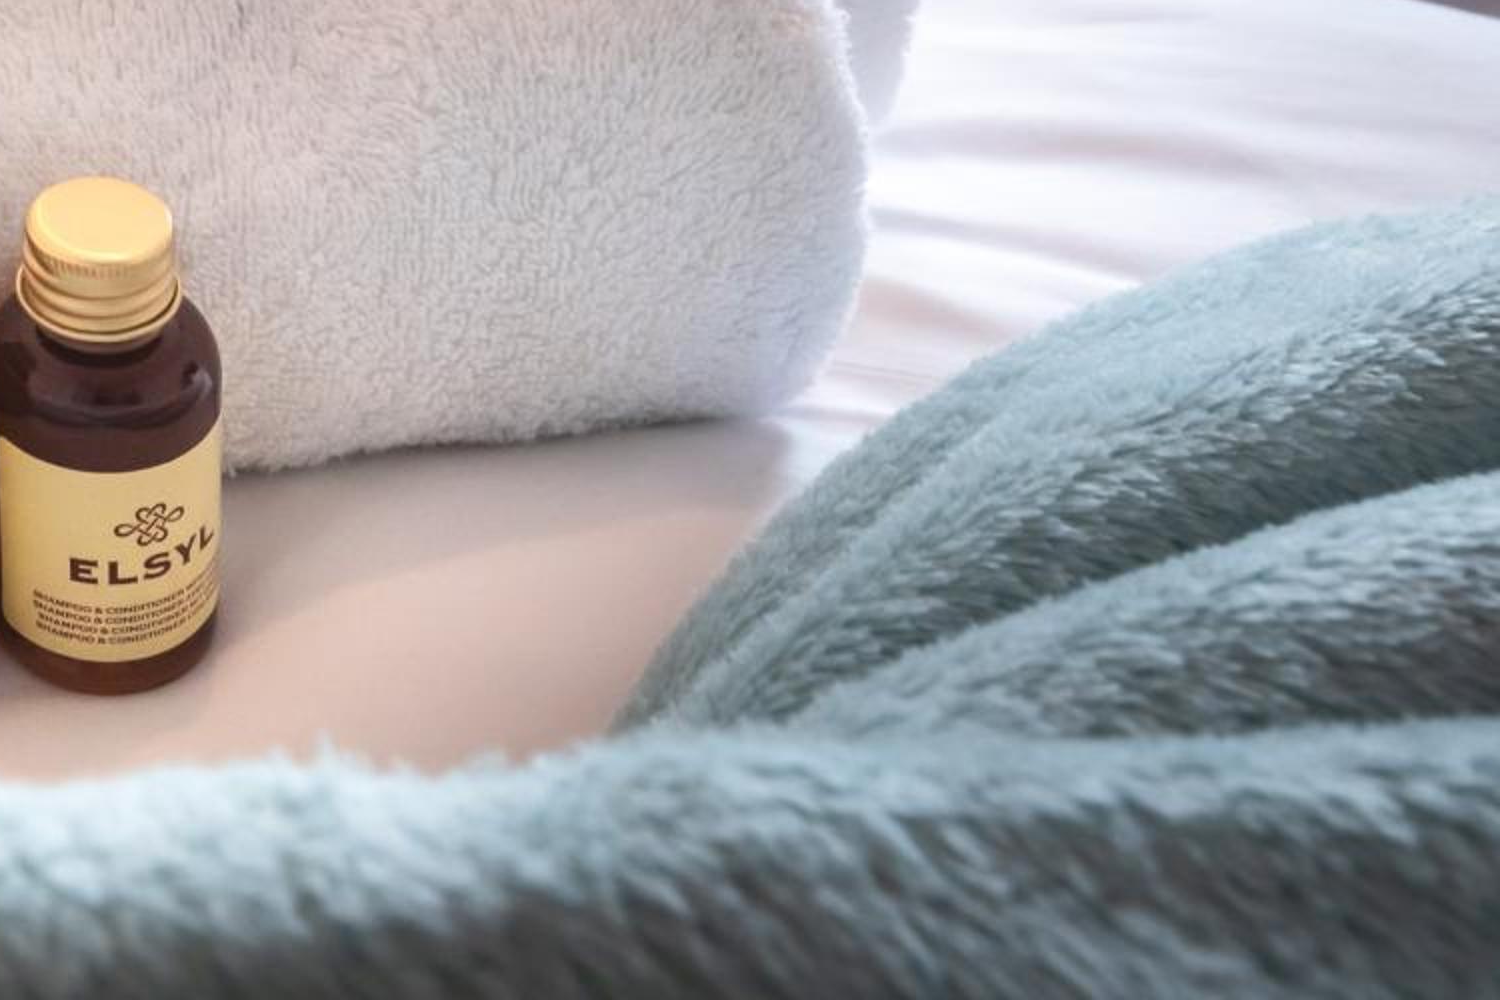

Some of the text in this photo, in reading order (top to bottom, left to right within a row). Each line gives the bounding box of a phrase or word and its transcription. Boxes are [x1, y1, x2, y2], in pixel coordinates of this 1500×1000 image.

[69, 525, 214, 585] ELSYL
[33, 588, 93, 614] SHAMPOO
[33, 598, 92, 624] SHAMPOO
[36, 619, 96, 643] SHAMPOO
[37, 610, 98, 633] SHAMPOO
